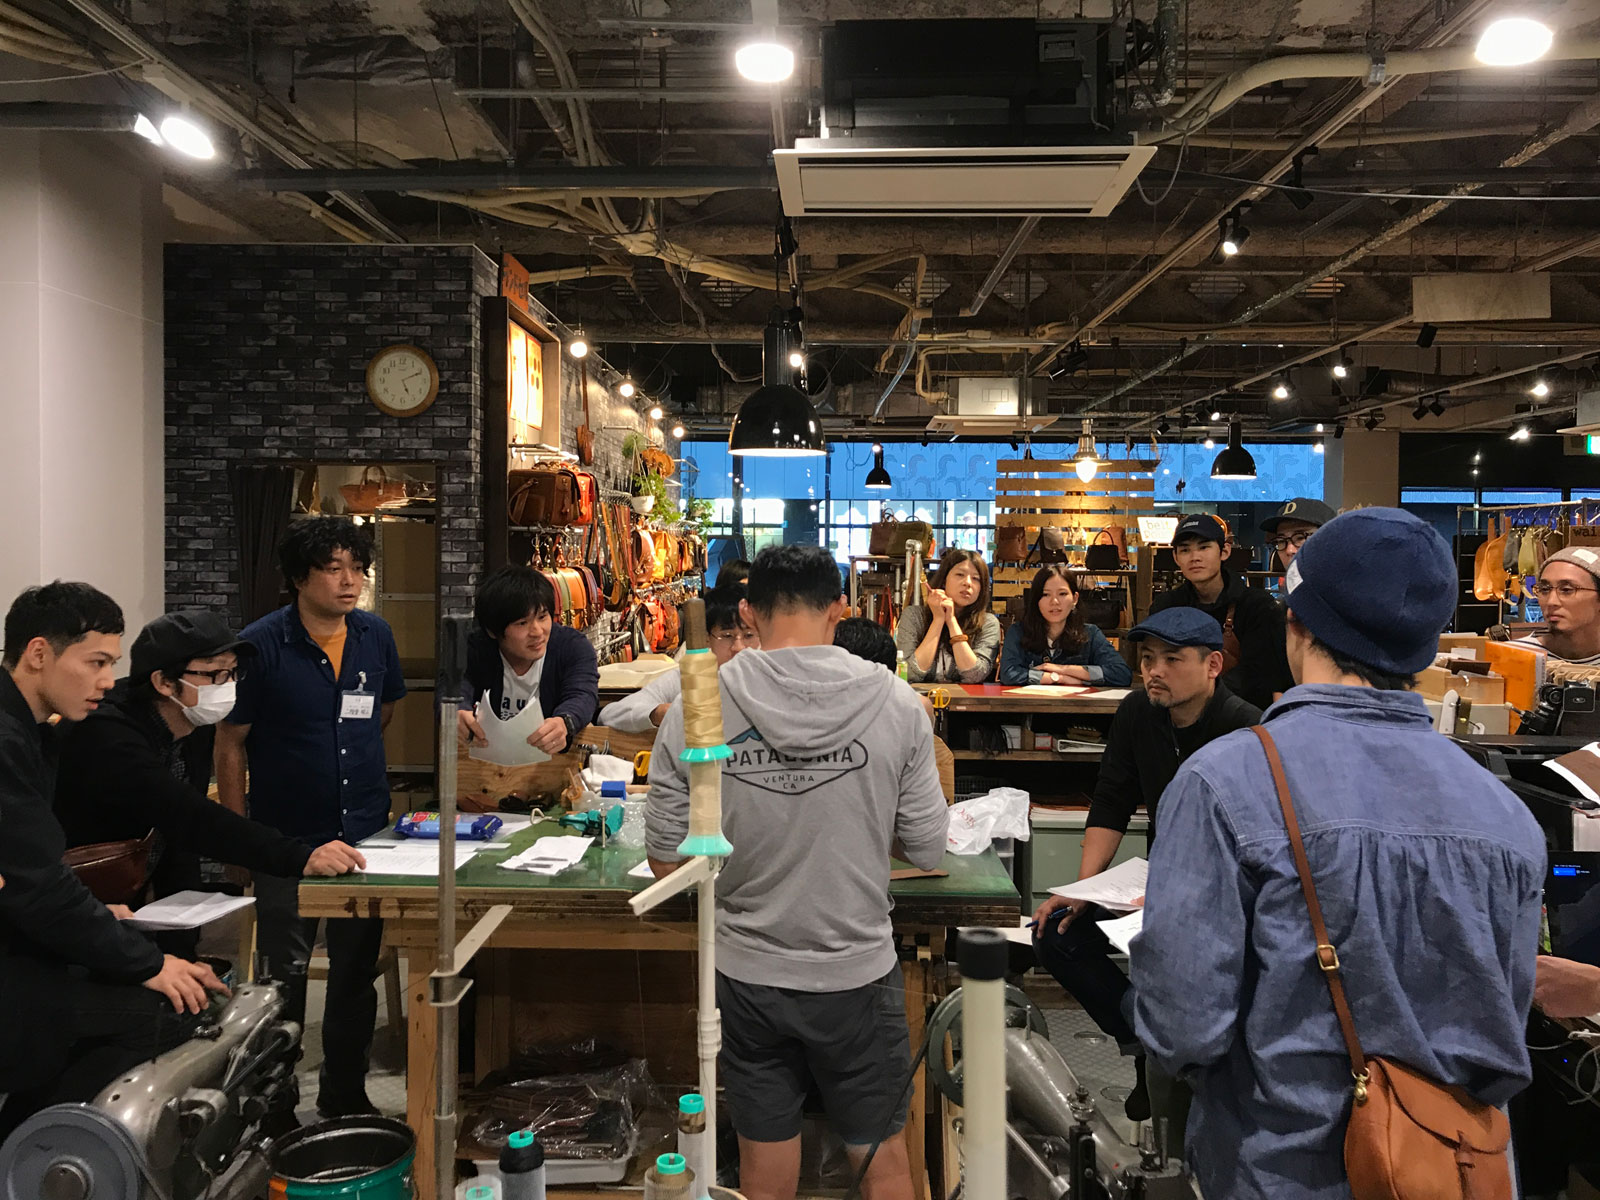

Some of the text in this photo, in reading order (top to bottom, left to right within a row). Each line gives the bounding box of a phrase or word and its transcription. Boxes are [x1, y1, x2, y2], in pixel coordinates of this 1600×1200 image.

[1283, 502, 1297, 516] D
[763, 773, 815, 784] VENTURA
[783, 782, 797, 790] CA
